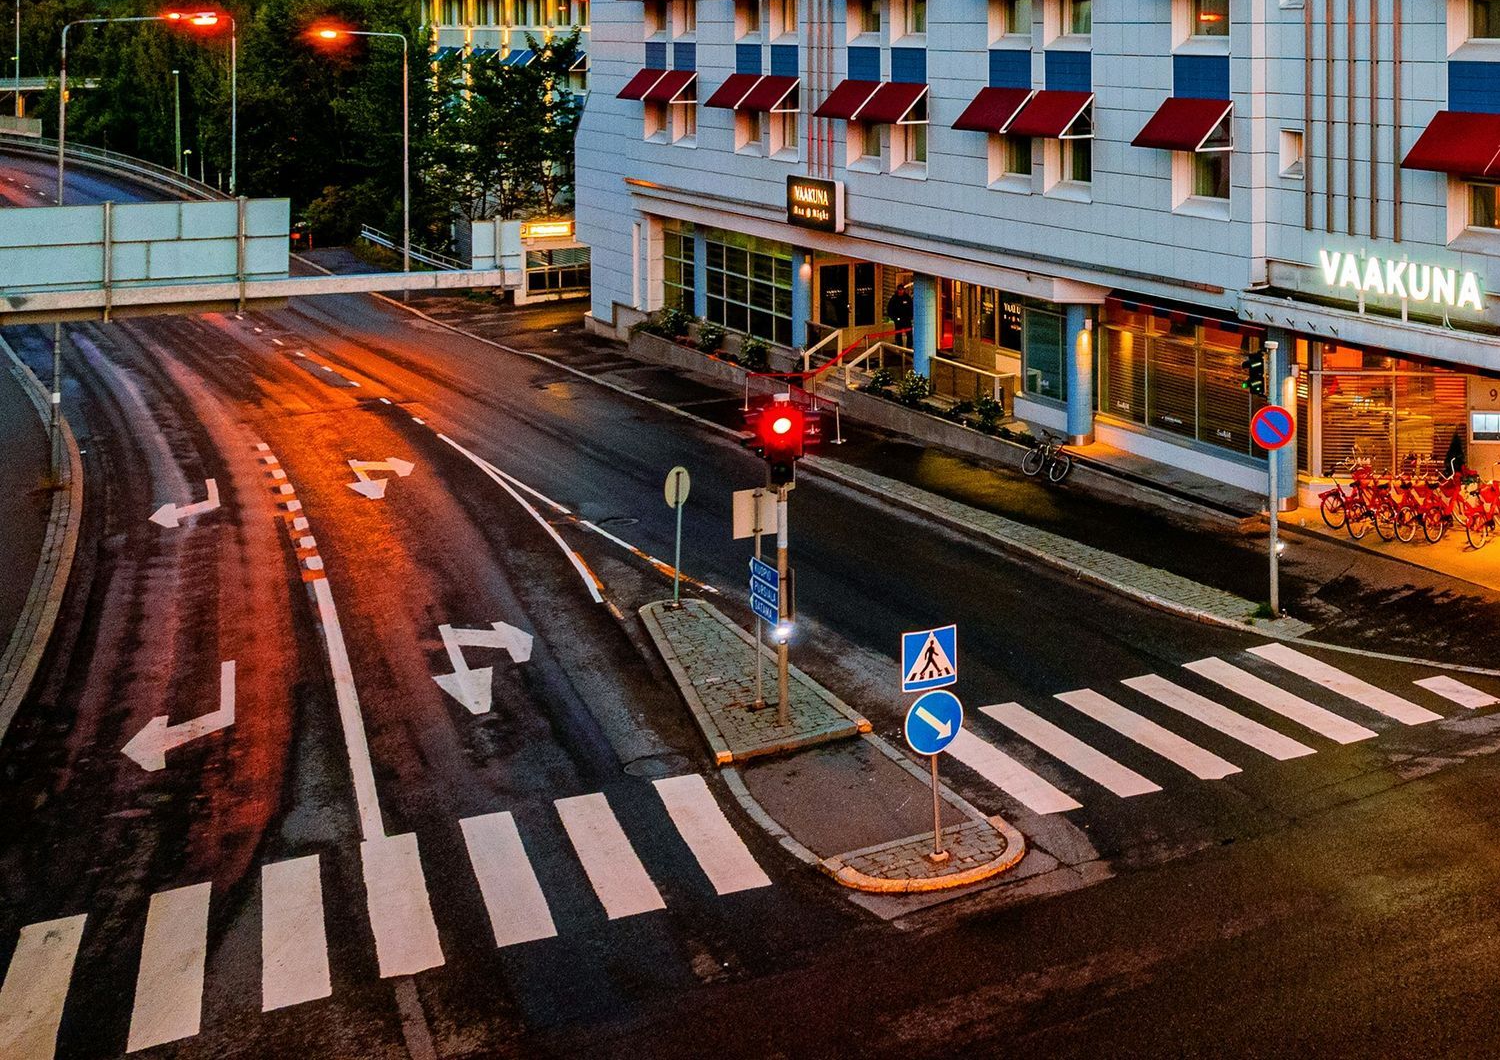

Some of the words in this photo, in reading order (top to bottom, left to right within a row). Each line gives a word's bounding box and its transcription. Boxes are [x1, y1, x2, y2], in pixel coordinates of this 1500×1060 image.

[794, 185, 829, 206] VAAKUNA
[1319, 249, 1483, 311] VAAKUNA
[1489, 388, 1498, 401] 9
